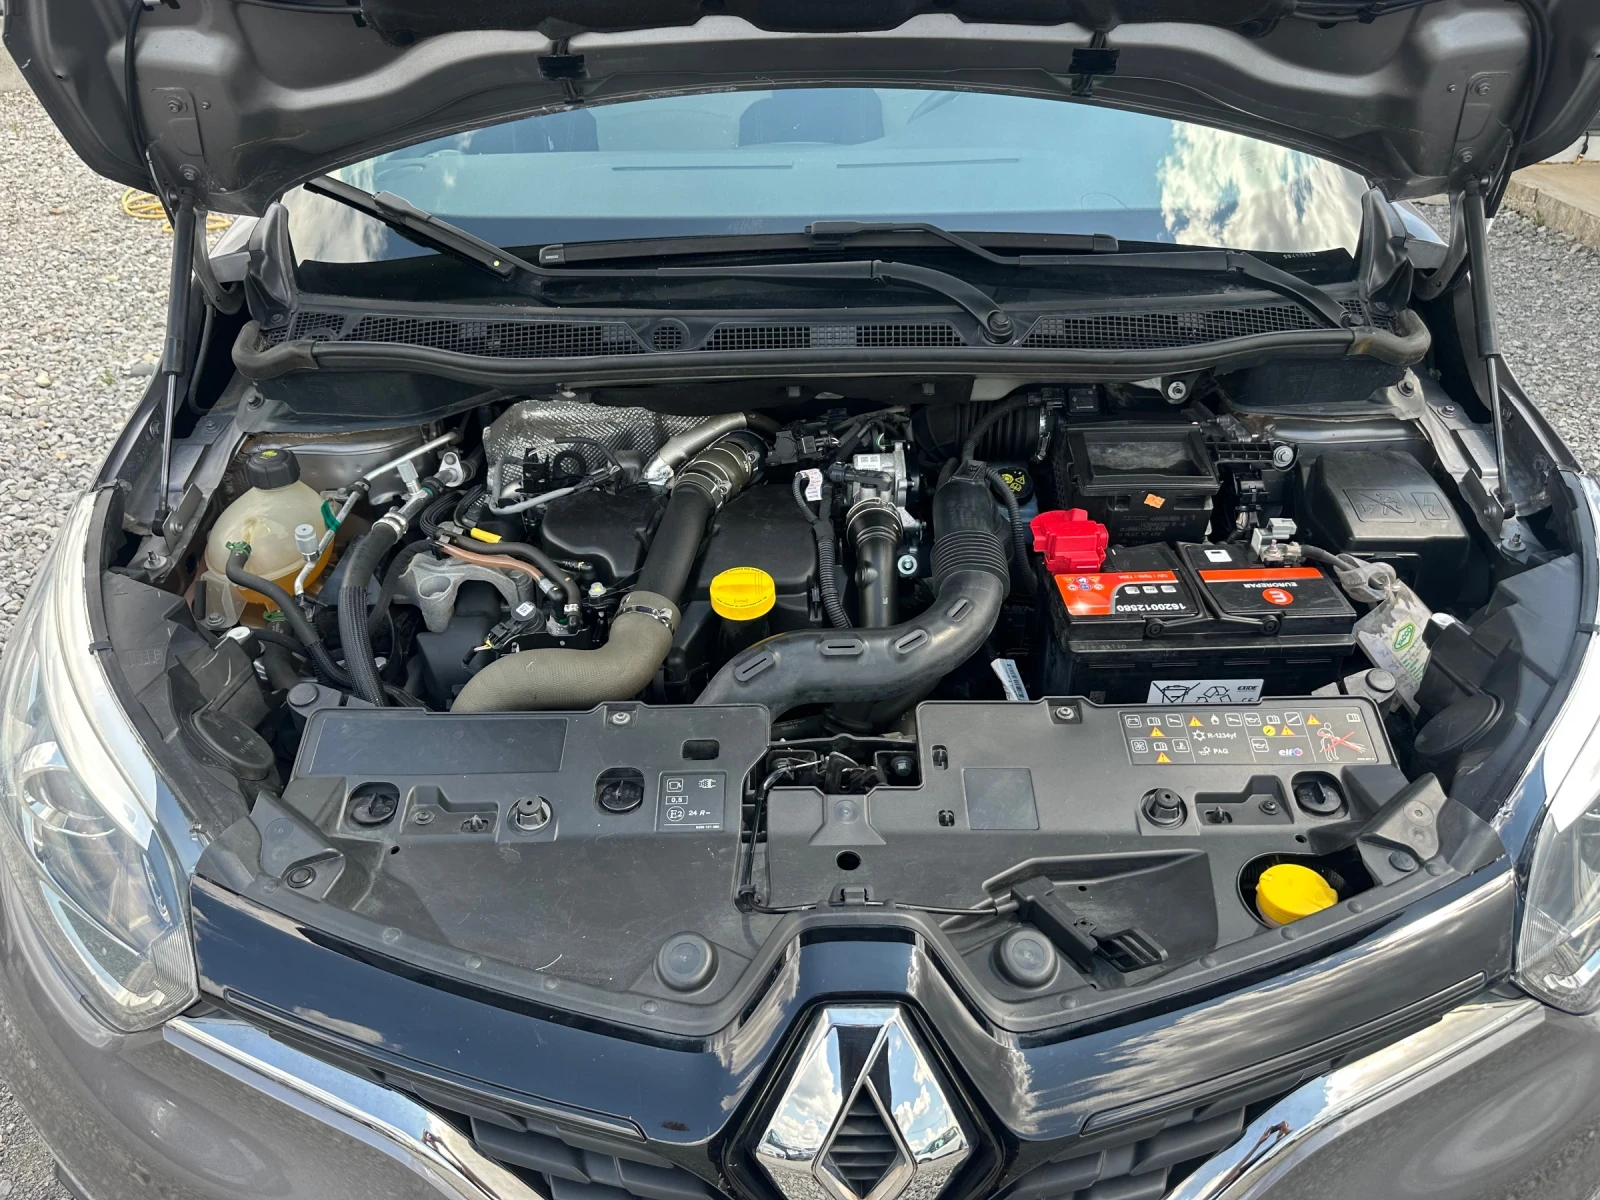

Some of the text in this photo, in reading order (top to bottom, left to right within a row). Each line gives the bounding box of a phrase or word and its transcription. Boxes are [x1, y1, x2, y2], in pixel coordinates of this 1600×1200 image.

[1117, 602, 1187, 612] 1620012580
[1396, 627, 1413, 647] YACCO
[1207, 732, 1236, 740] R-1234yf
[1213, 747, 1229, 755] PAG
[1278, 747, 1293, 757] elf
[670, 809, 683, 819] E2
